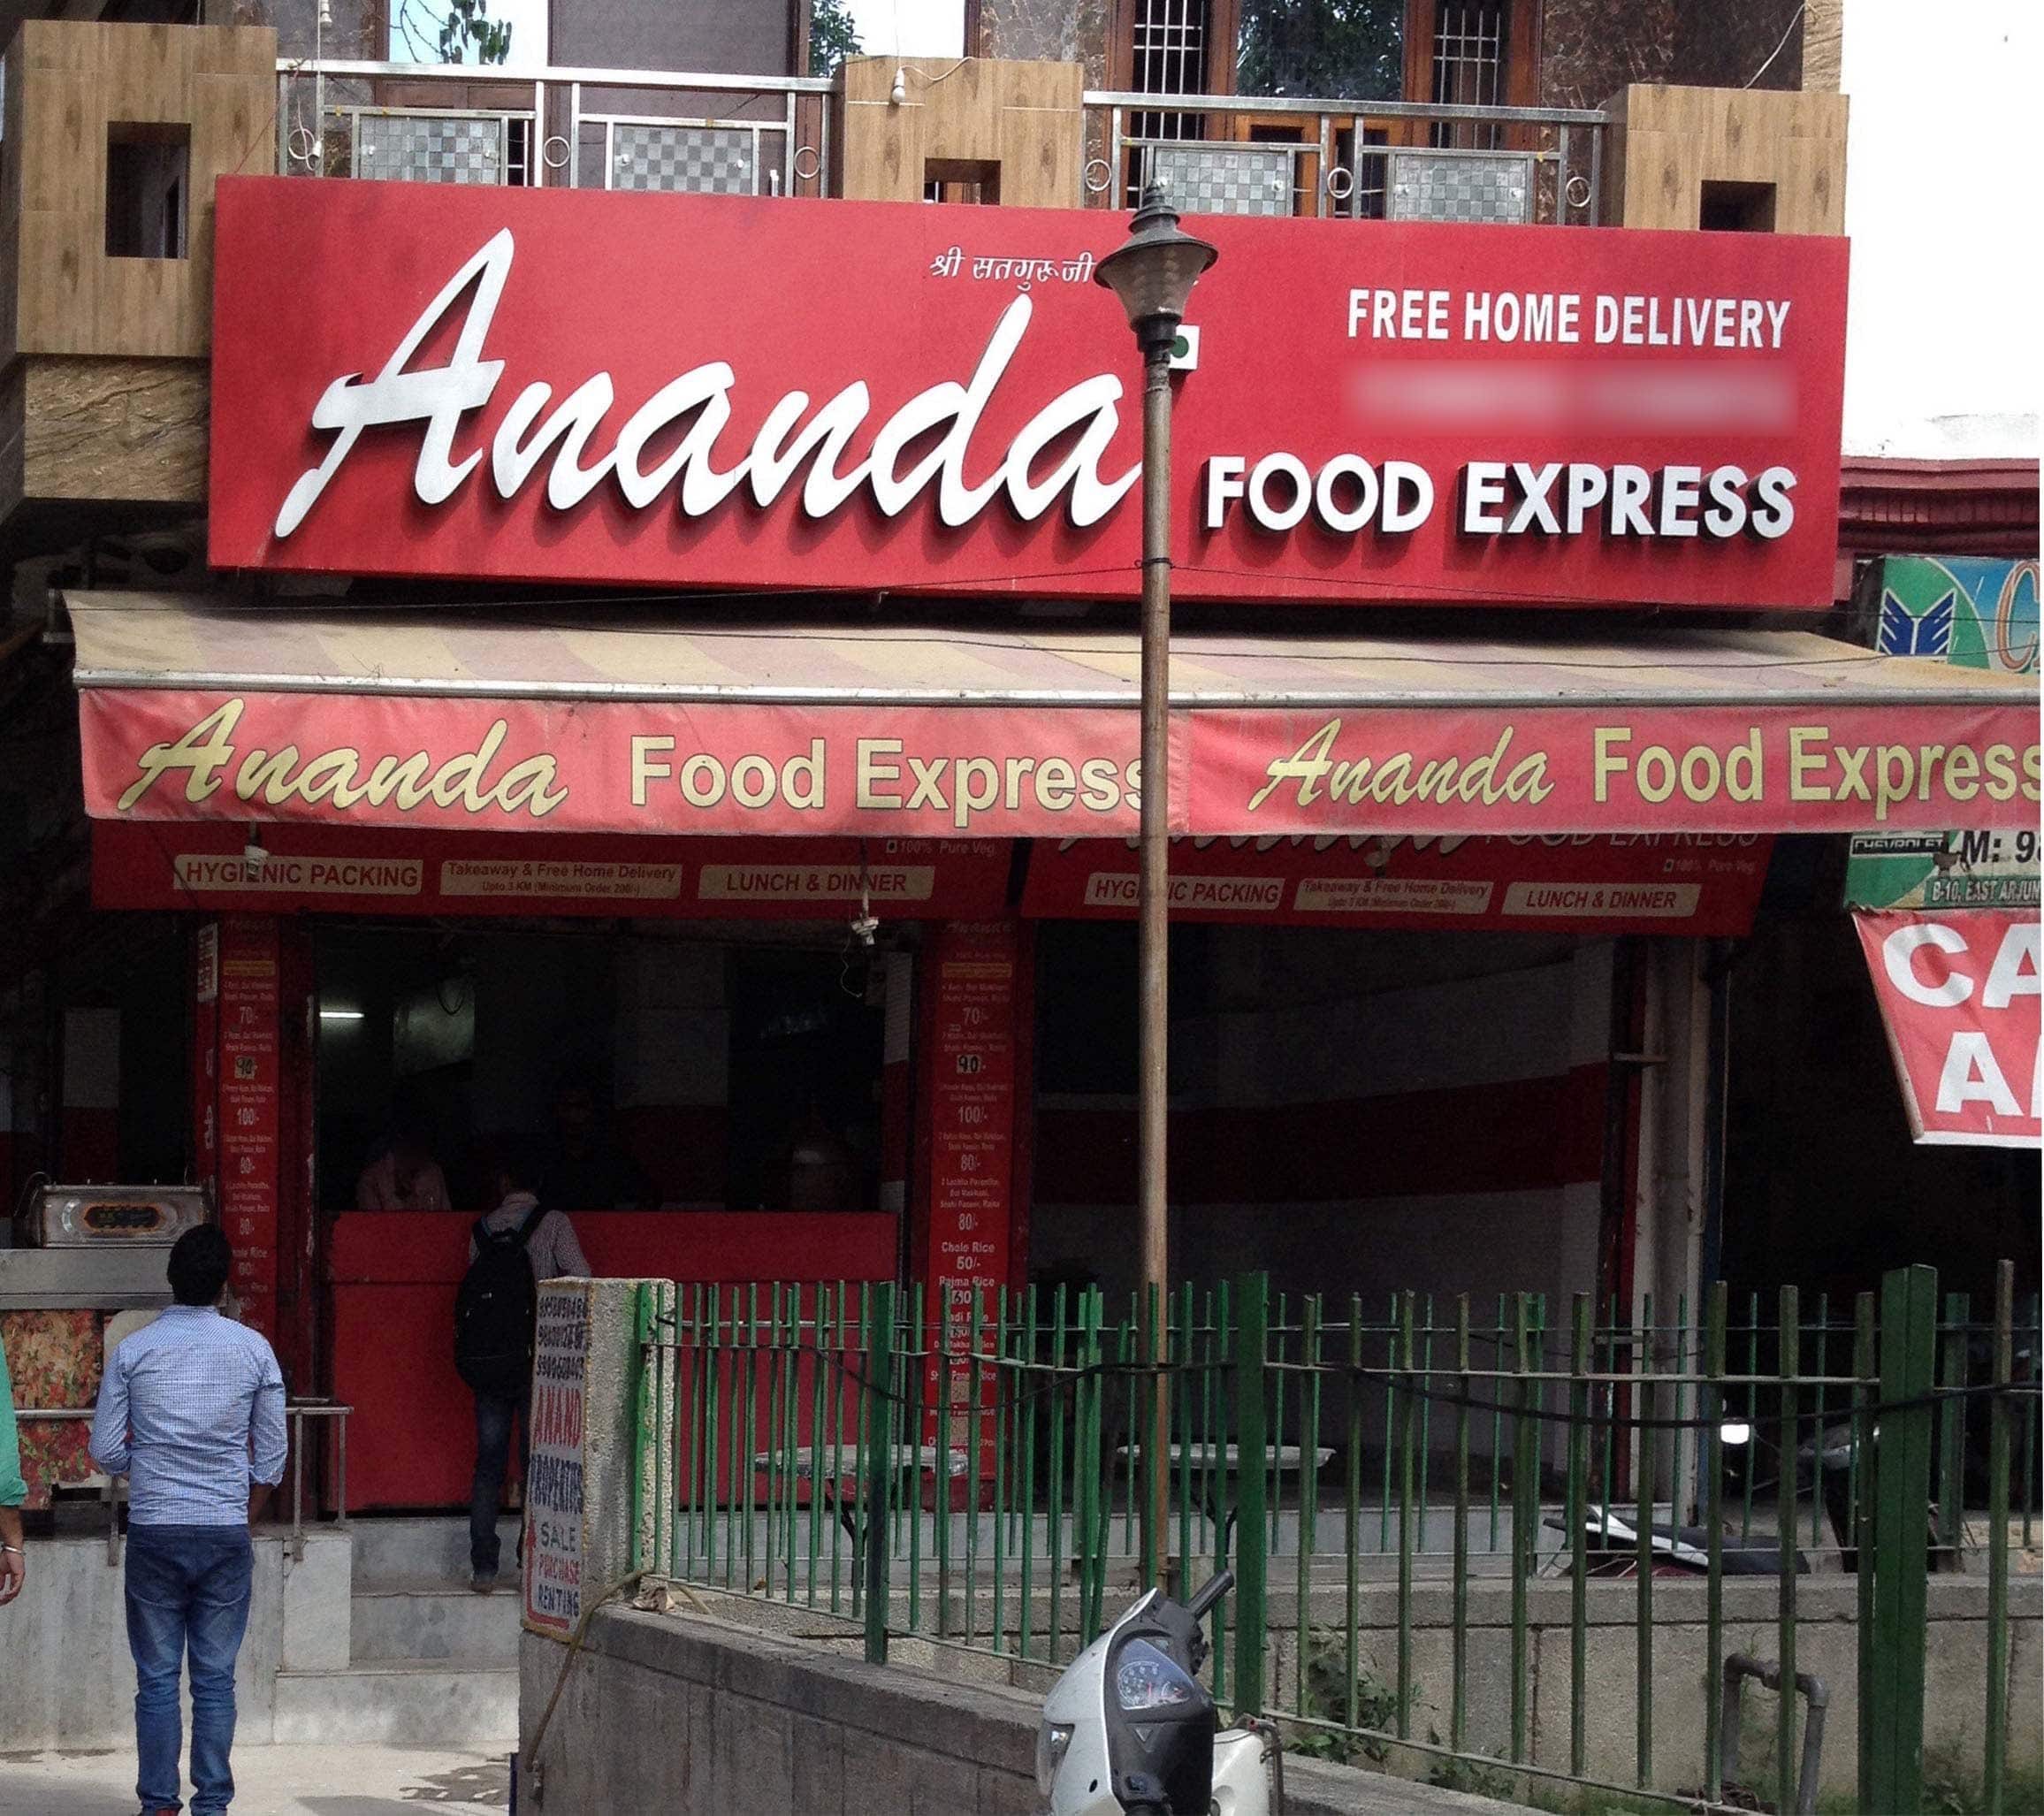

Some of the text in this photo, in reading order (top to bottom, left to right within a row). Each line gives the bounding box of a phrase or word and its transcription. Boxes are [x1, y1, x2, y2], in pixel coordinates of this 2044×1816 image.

[930, 246, 965, 278] श्री
[1346, 288, 1792, 348] FREE HOME DELIVERY
[274, 228, 1144, 538] Ananda
[1206, 451, 1798, 538] FOOD EXPRESS
[117, 697, 569, 818] Ananda
[629, 735, 827, 810] Food
[1248, 718, 1555, 812] Ananda
[1593, 727, 1765, 804] Food
[938, 841, 970, 855] Pure
[1960, 830, 2041, 864] M: 9
[310, 864, 418, 887] PACKING
[449, 862, 675, 881] Takeaway & Free Home Delivery
[726, 874, 907, 893] LUNCH & DINNER
[1193, 881, 1279, 904] PACKING
[1526, 890, 1677, 909] LUNCH & DINNER
[1965, 881, 1998, 902] EAST
[972, 1240, 996, 1254] Rice
[533, 1385, 582, 1450] ANAND
[540, 1522, 577, 1553] SALE
[538, 1554, 580, 1585] PURCHASE
[538, 1584, 579, 1617] RENTING
